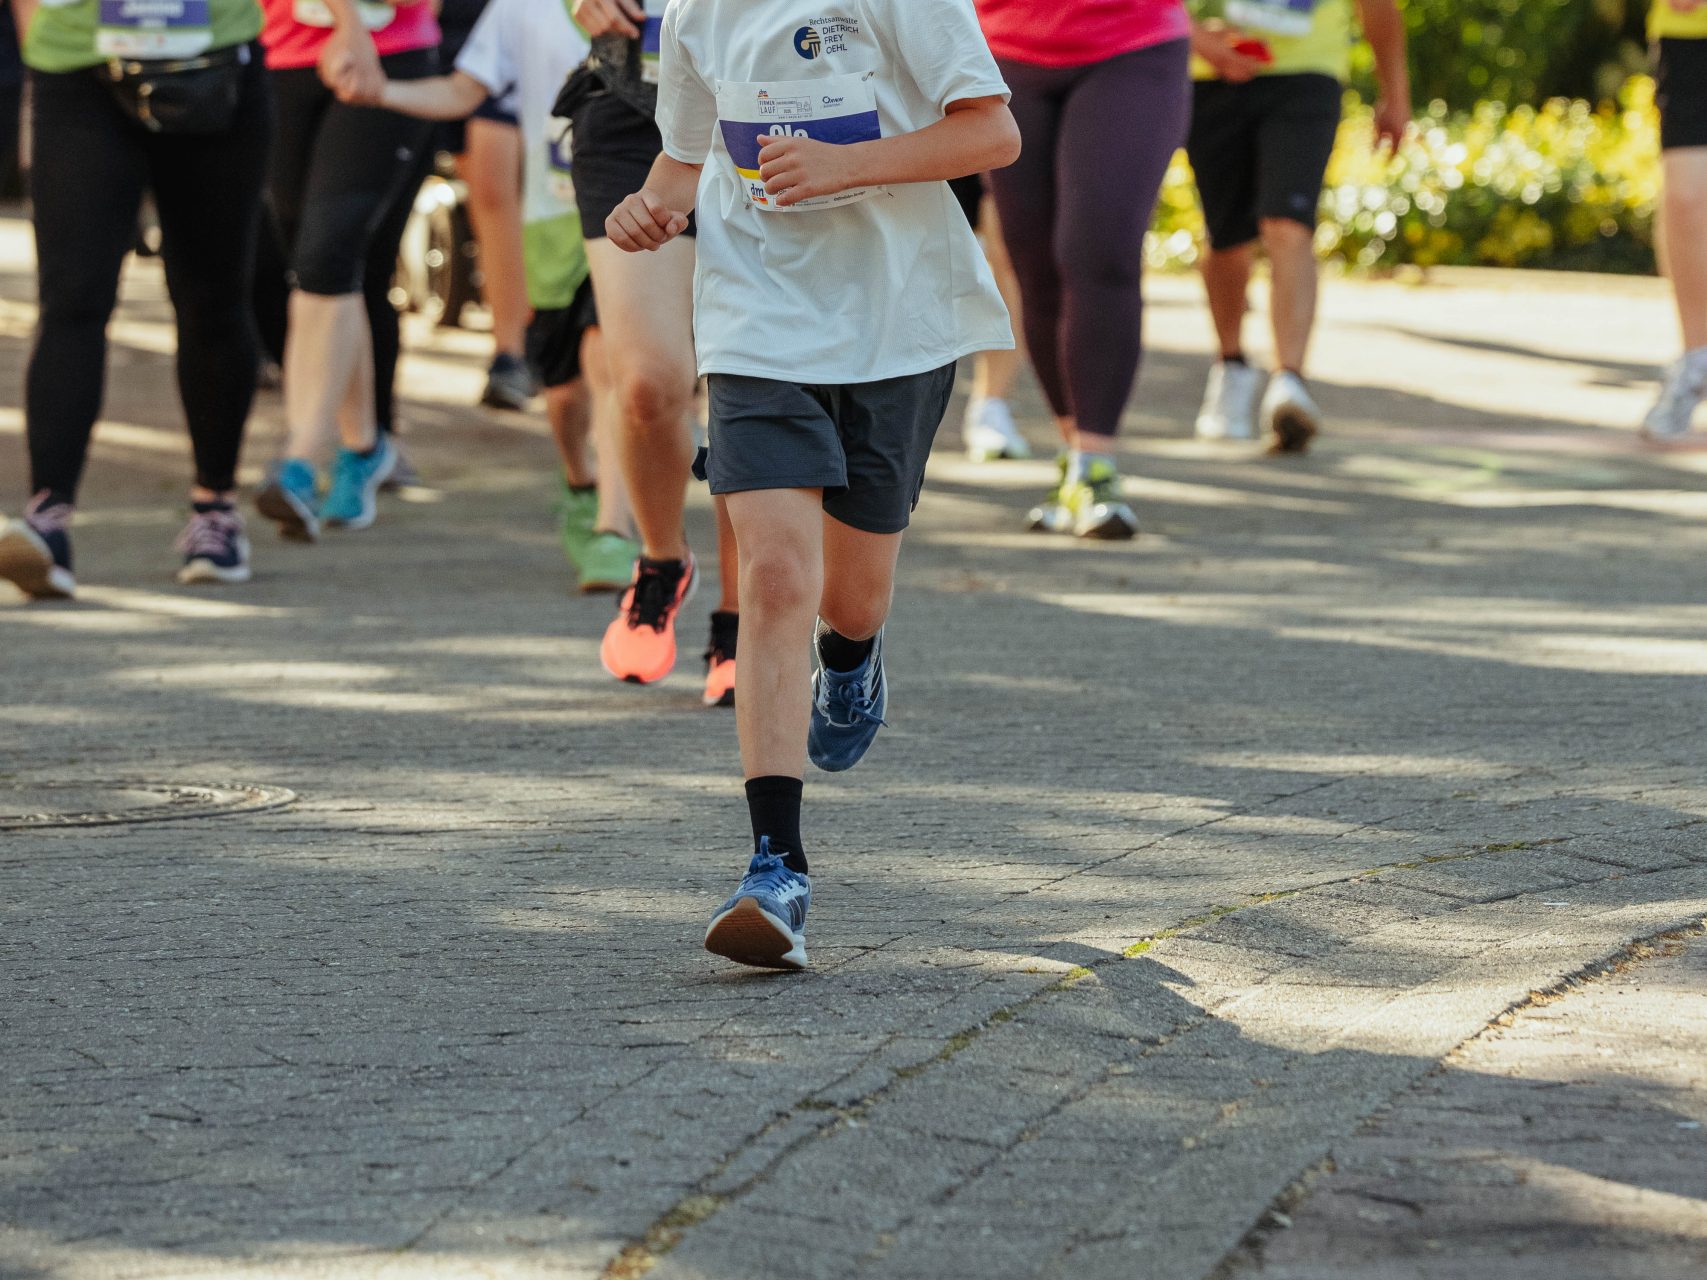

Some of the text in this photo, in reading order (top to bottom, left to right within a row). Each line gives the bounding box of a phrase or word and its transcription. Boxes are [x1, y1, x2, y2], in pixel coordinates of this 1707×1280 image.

[822, 25, 858, 34] DIETRICH
[824, 34, 843, 44] FREY
[826, 44, 847, 54] OEHL
[760, 106, 775, 114] LAUF
[750, 183, 764, 197] dm
